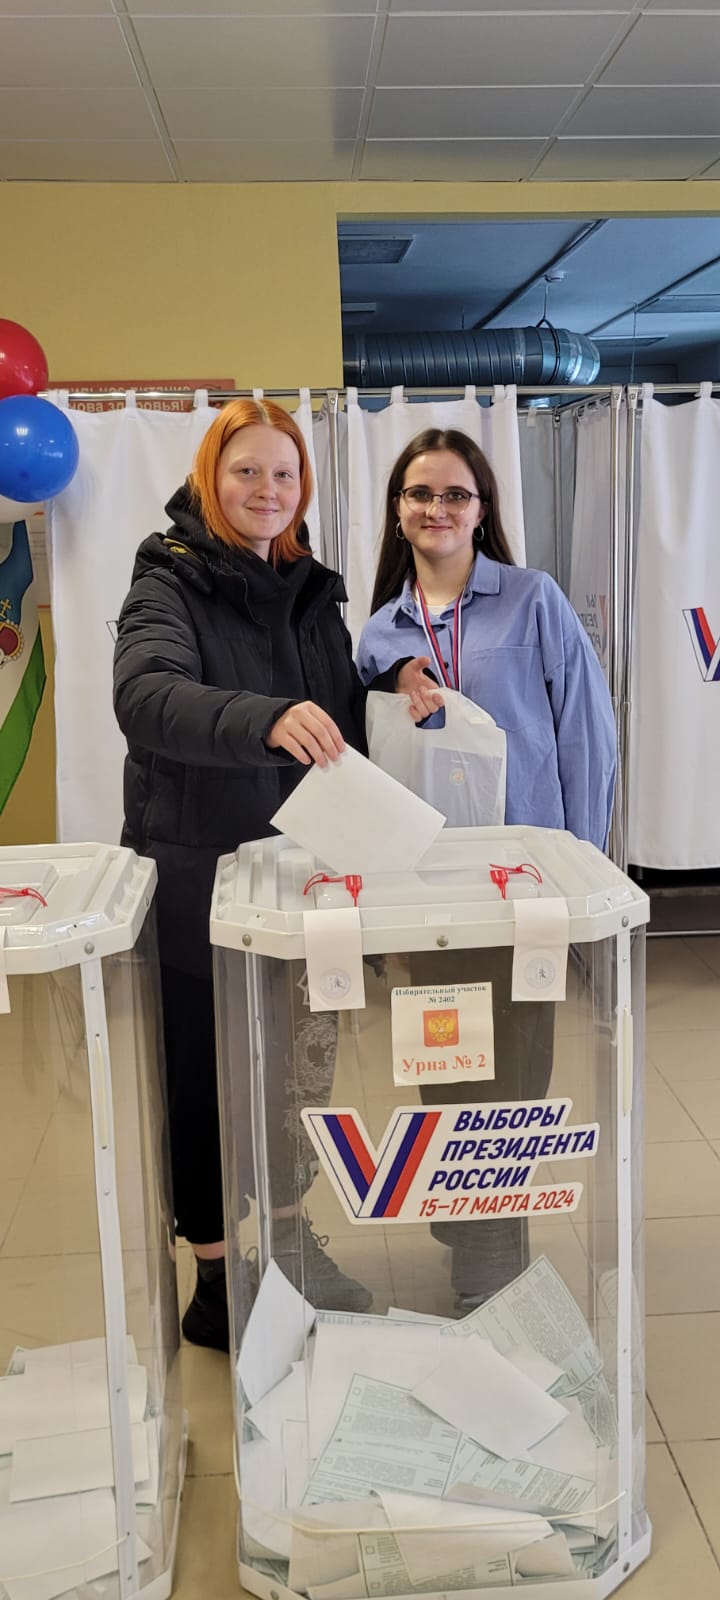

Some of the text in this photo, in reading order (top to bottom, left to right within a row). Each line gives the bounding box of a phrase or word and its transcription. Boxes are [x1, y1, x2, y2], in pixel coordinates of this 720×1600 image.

[395, 985, 487, 996] Избирательный участок
[402, 1054, 486, 1075] Урна № 2
[453, 1104, 566, 1132] ВЫБОРЫ
[440, 1130, 596, 1162] ПРЕЗИДЕНТА
[428, 1166, 531, 1191] РОССИИ
[470, 1192, 529, 1215] МАРТА
[533, 1189, 575, 1211] 2024
